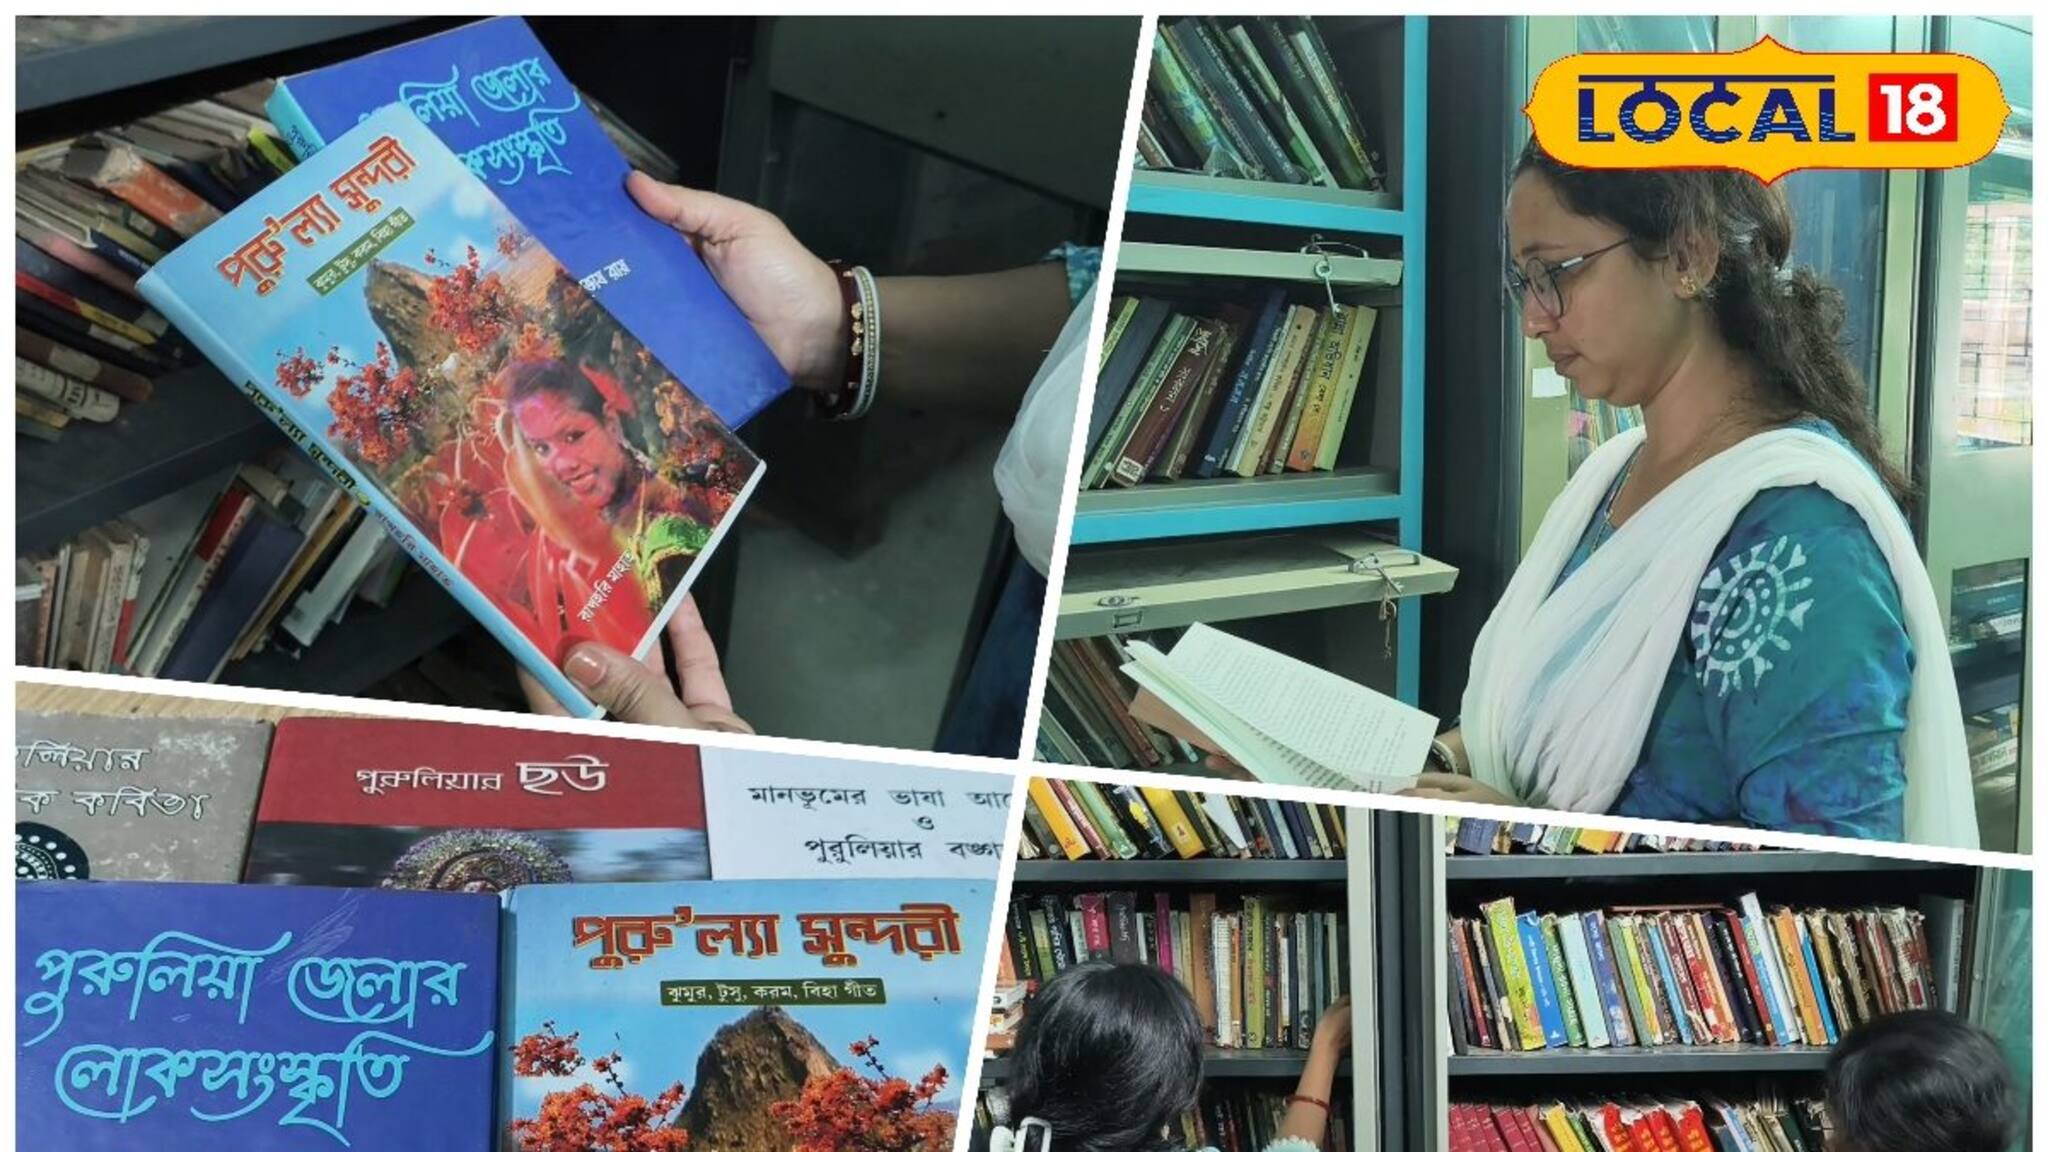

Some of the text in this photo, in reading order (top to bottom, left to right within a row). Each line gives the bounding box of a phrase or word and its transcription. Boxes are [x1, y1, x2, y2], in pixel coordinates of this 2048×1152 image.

[470, 57, 552, 113] জেলার
[328, 135, 417, 213] সুন্দরী
[356, 754, 610, 796] পুরুলিয়ার ছউ
[72, 786, 211, 820] কবিতা
[747, 786, 867, 811] মানভূমের
[912, 815, 936, 831] ও
[804, 833, 923, 865] পুরুলিয়ার
[797, 902, 961, 968] সুন্দরী
[22, 930, 467, 1047] পুরুলিয়া জেলার
[665, 979, 879, 1003] ঝুমুর, টুসু, করম, বিহা গীত
[54, 1030, 496, 1147] লোকসংস্কৃতি
